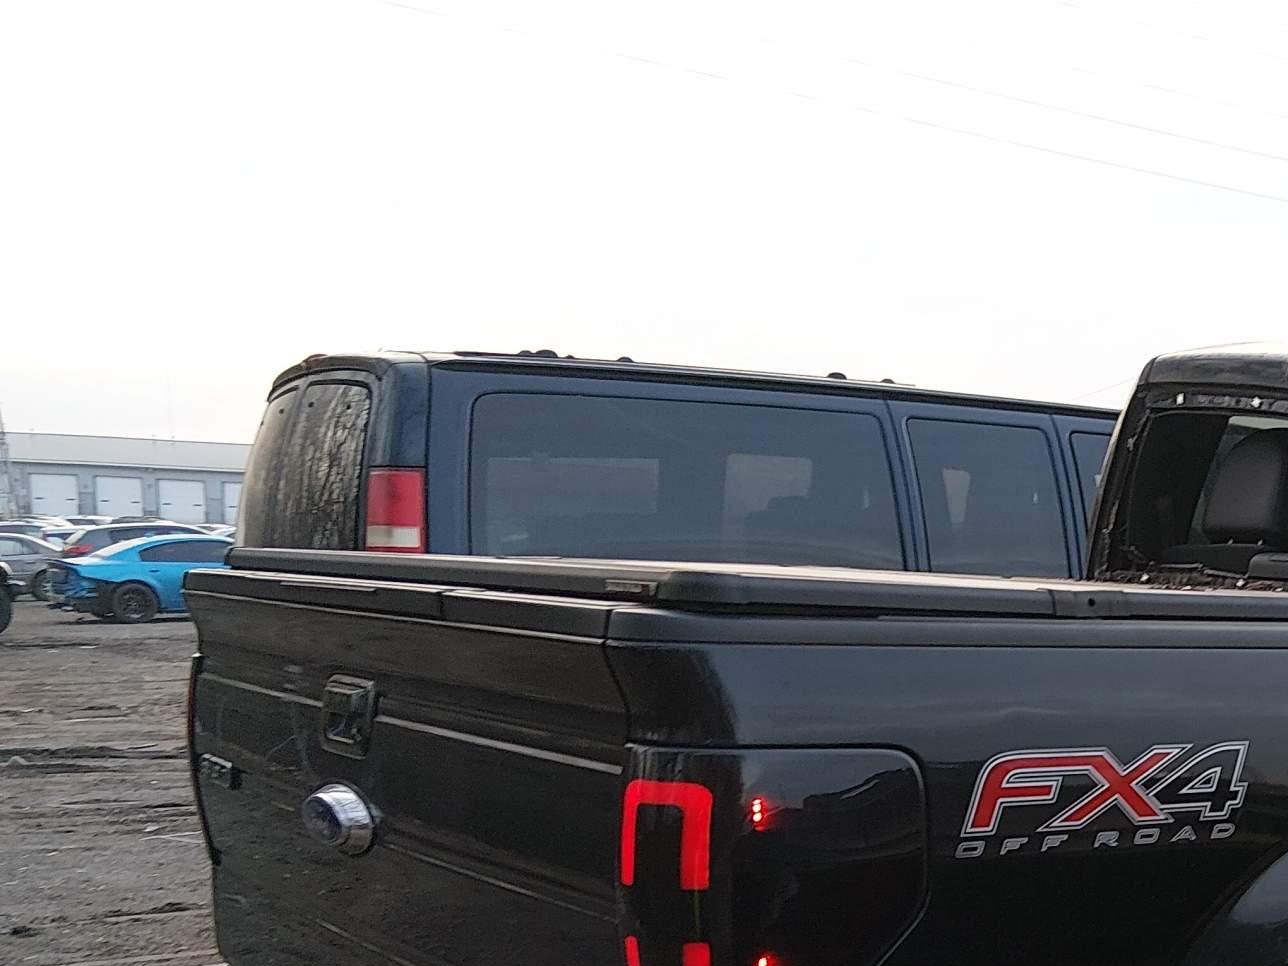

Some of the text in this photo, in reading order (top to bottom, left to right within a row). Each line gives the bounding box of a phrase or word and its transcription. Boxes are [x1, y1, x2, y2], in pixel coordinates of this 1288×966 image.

[959, 740, 1250, 838] FX4
[954, 822, 1236, 858] OFF ROAD
